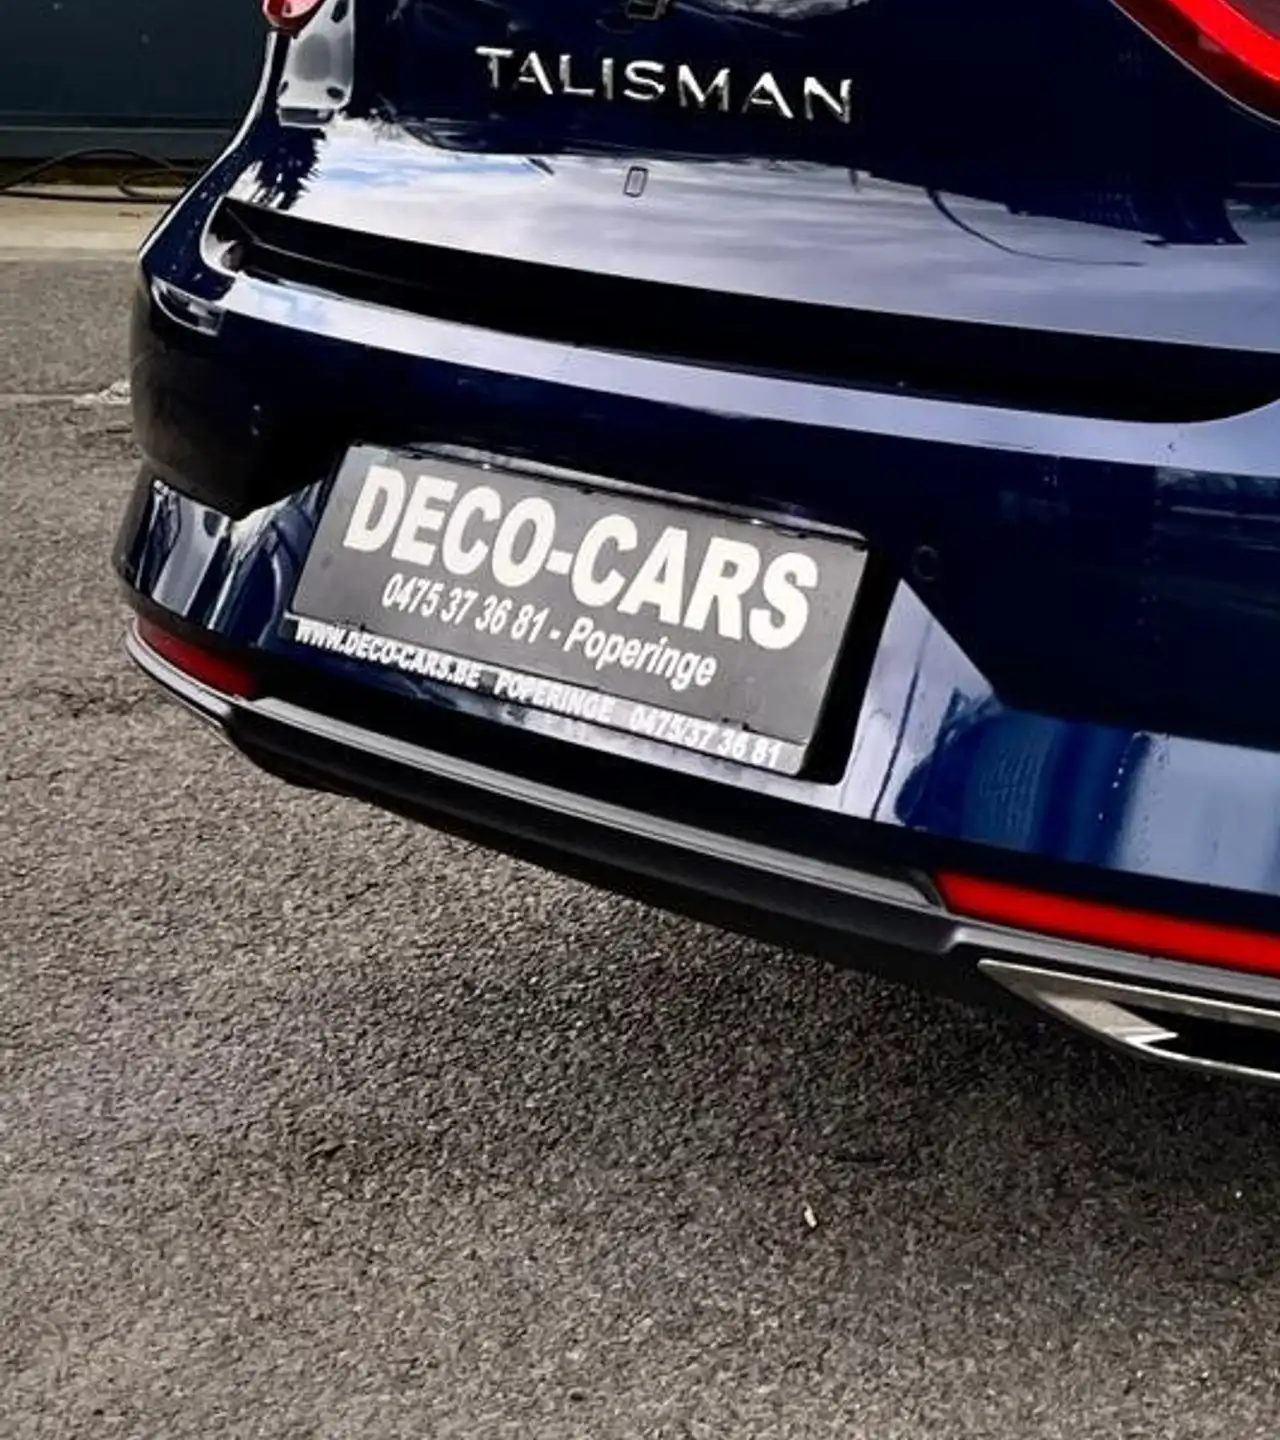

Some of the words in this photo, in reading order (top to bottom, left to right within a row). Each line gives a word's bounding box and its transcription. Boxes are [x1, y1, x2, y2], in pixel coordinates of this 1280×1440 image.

[475, 46, 853, 124] TALISMAN
[343, 464, 819, 650] DECO-CARS
[295, 618, 482, 689] WWW.DECO-CARS.BE
[494, 670, 616, 722] POPERINGE
[716, 726, 746, 759] 36
[751, 737, 784, 768] 81
[382, 573, 444, 616] 0475
[441, 587, 478, 625] 37
[475, 594, 512, 635] 36
[510, 604, 549, 643] 81
[563, 616, 717, 691] Poperinge
